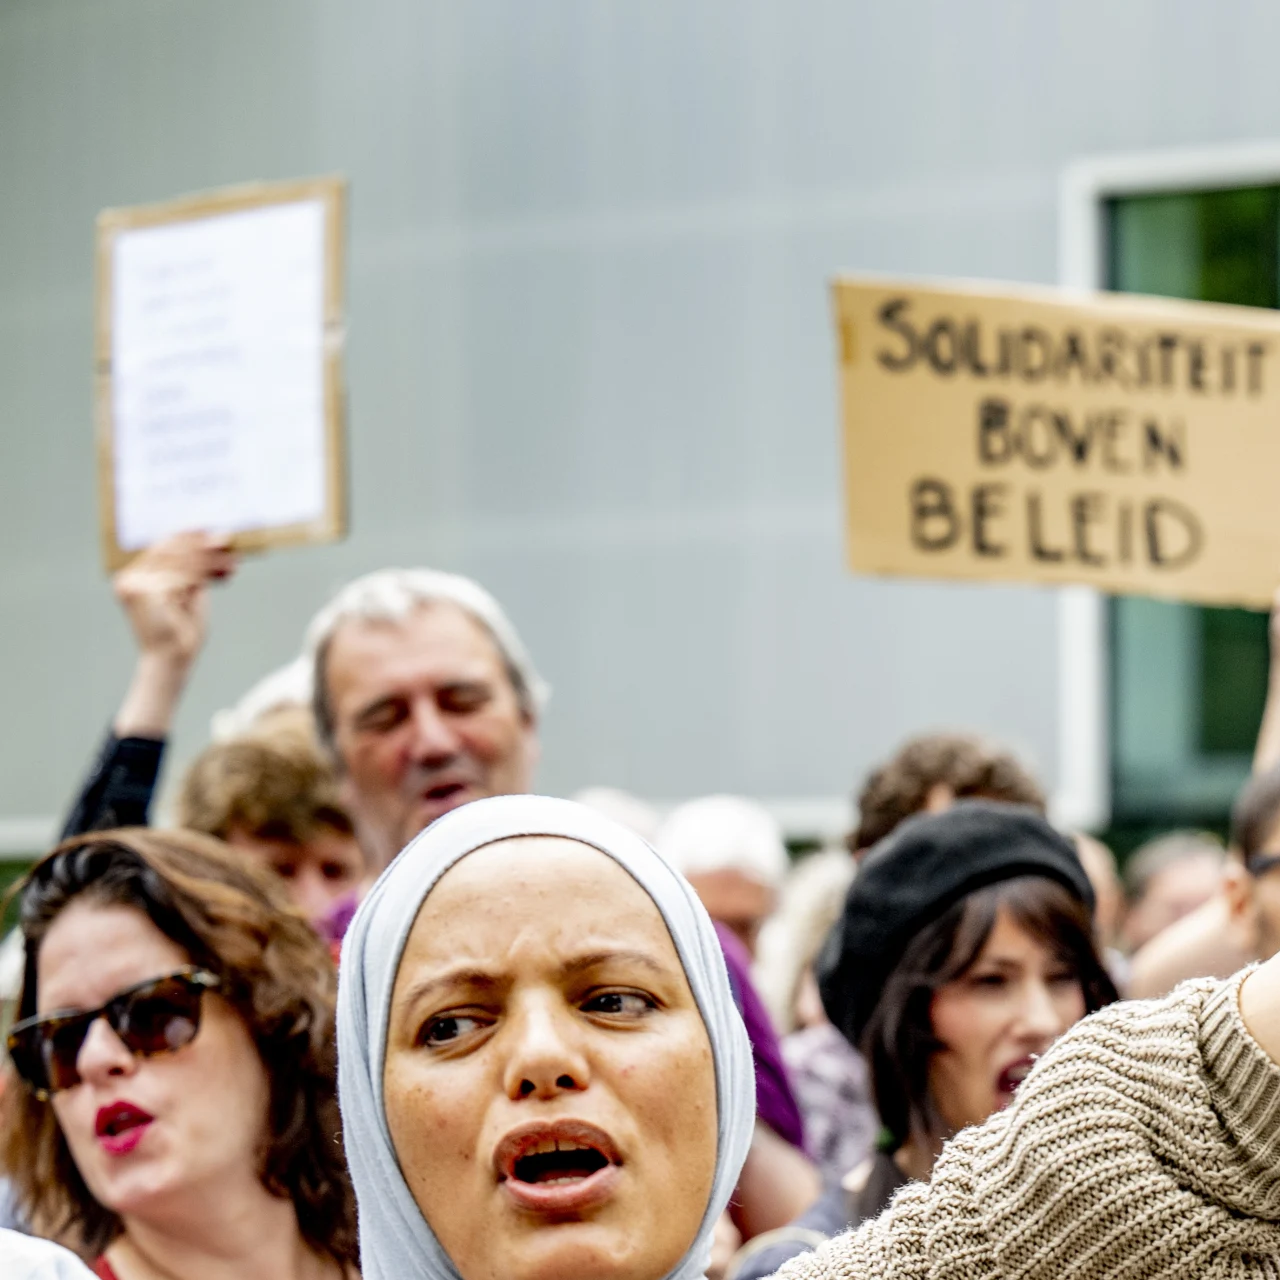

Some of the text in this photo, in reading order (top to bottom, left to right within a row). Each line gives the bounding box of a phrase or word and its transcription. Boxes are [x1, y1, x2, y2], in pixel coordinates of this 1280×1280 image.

[875, 294, 1271, 397] SOLIDARITEIT
[976, 395, 1186, 472] BOVEN
[909, 476, 1206, 571] BELEID
